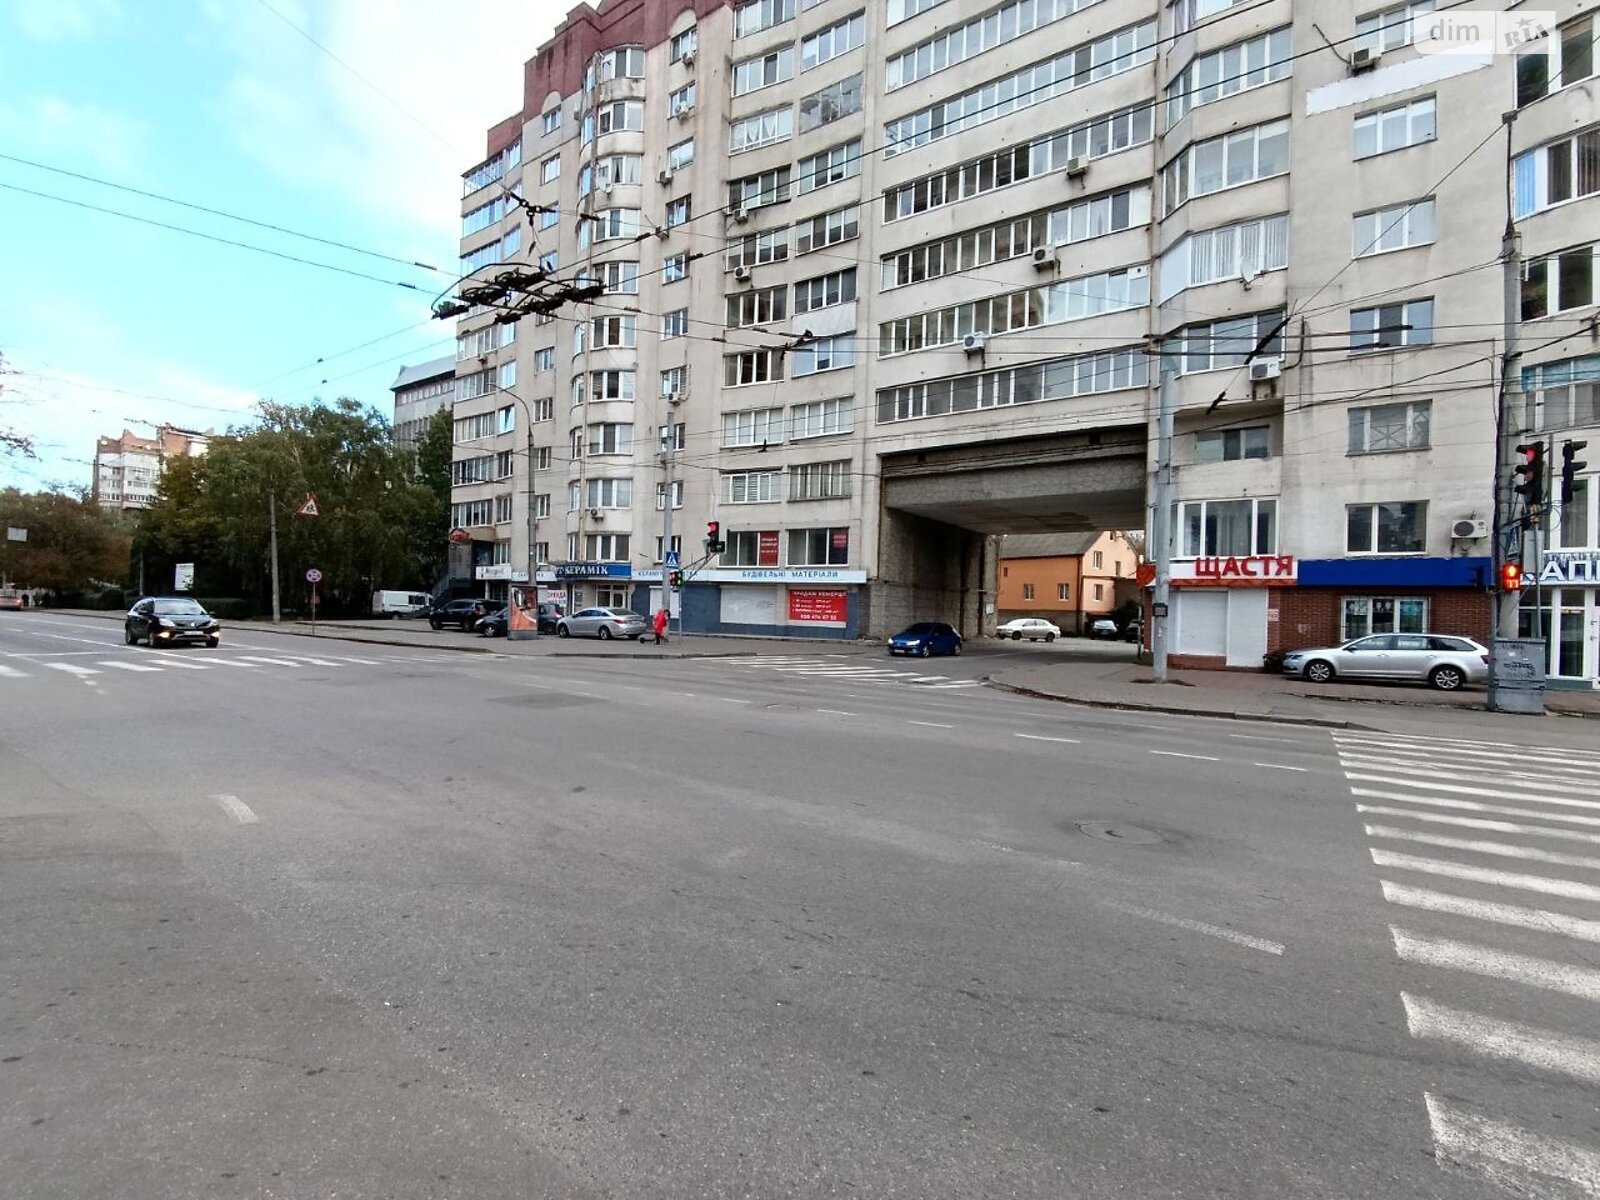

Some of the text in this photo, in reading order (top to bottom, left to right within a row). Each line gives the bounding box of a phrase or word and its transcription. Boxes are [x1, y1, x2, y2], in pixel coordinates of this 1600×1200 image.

[742, 569, 839, 579] БУДІВЕЛЬНІ МАТЕРІАЛИ
[1195, 555, 1293, 580] ЩАСТЯ
